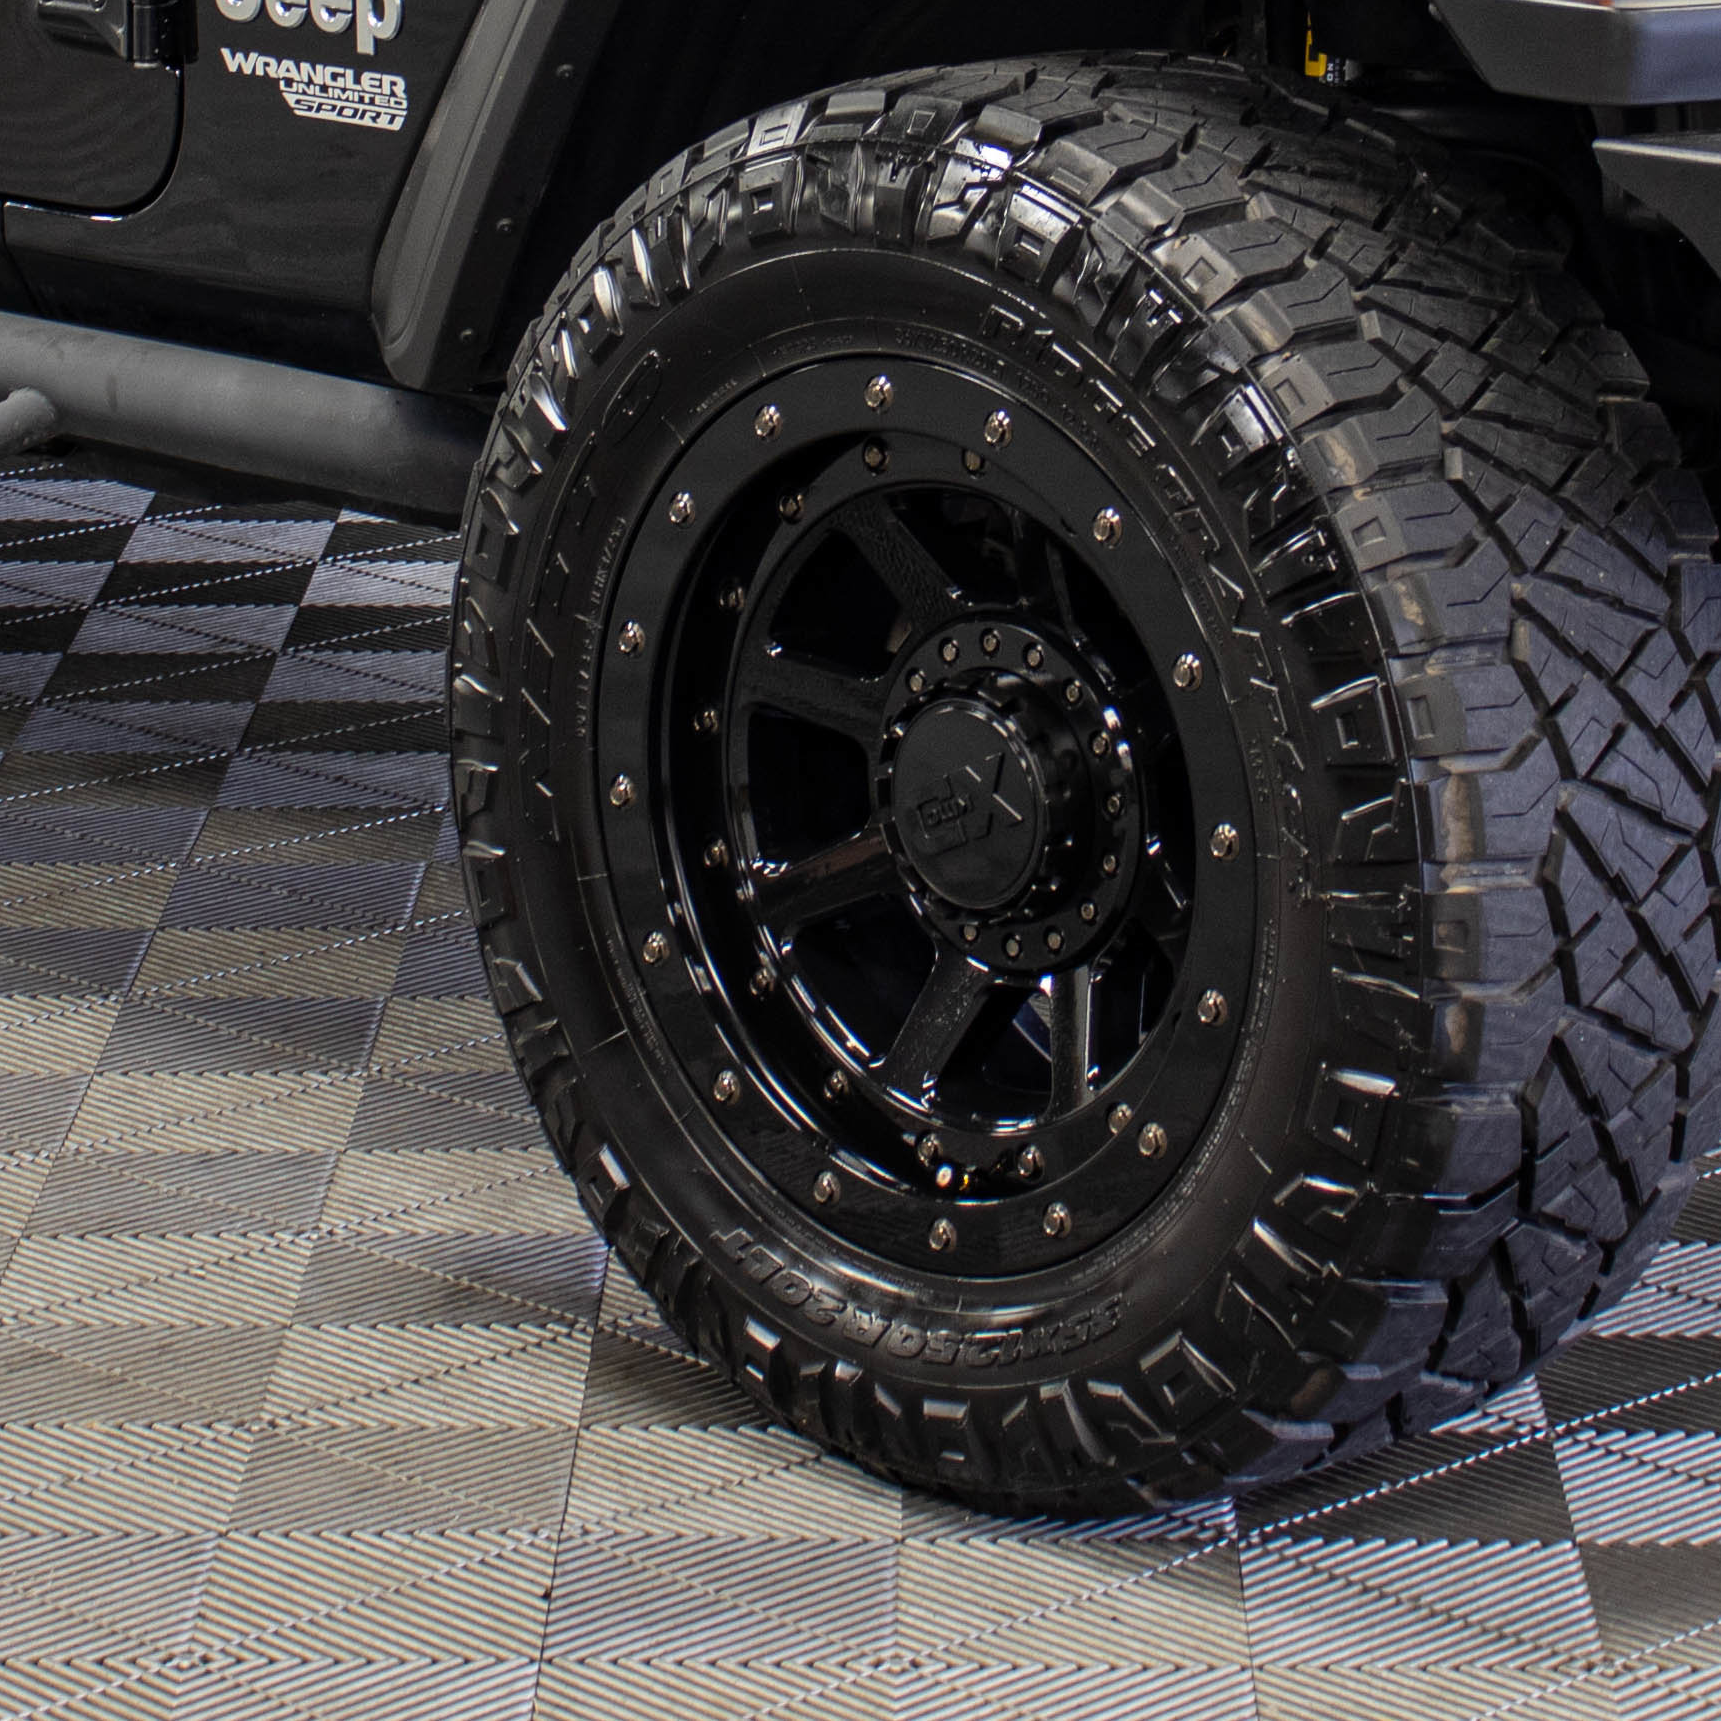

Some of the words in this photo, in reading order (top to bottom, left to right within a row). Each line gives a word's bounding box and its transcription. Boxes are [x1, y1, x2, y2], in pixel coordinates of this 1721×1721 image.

[220, 47, 408, 99] WRANGLER
[279, 79, 408, 109] UNLIMITED
[290, 95, 404, 128] SPORT
